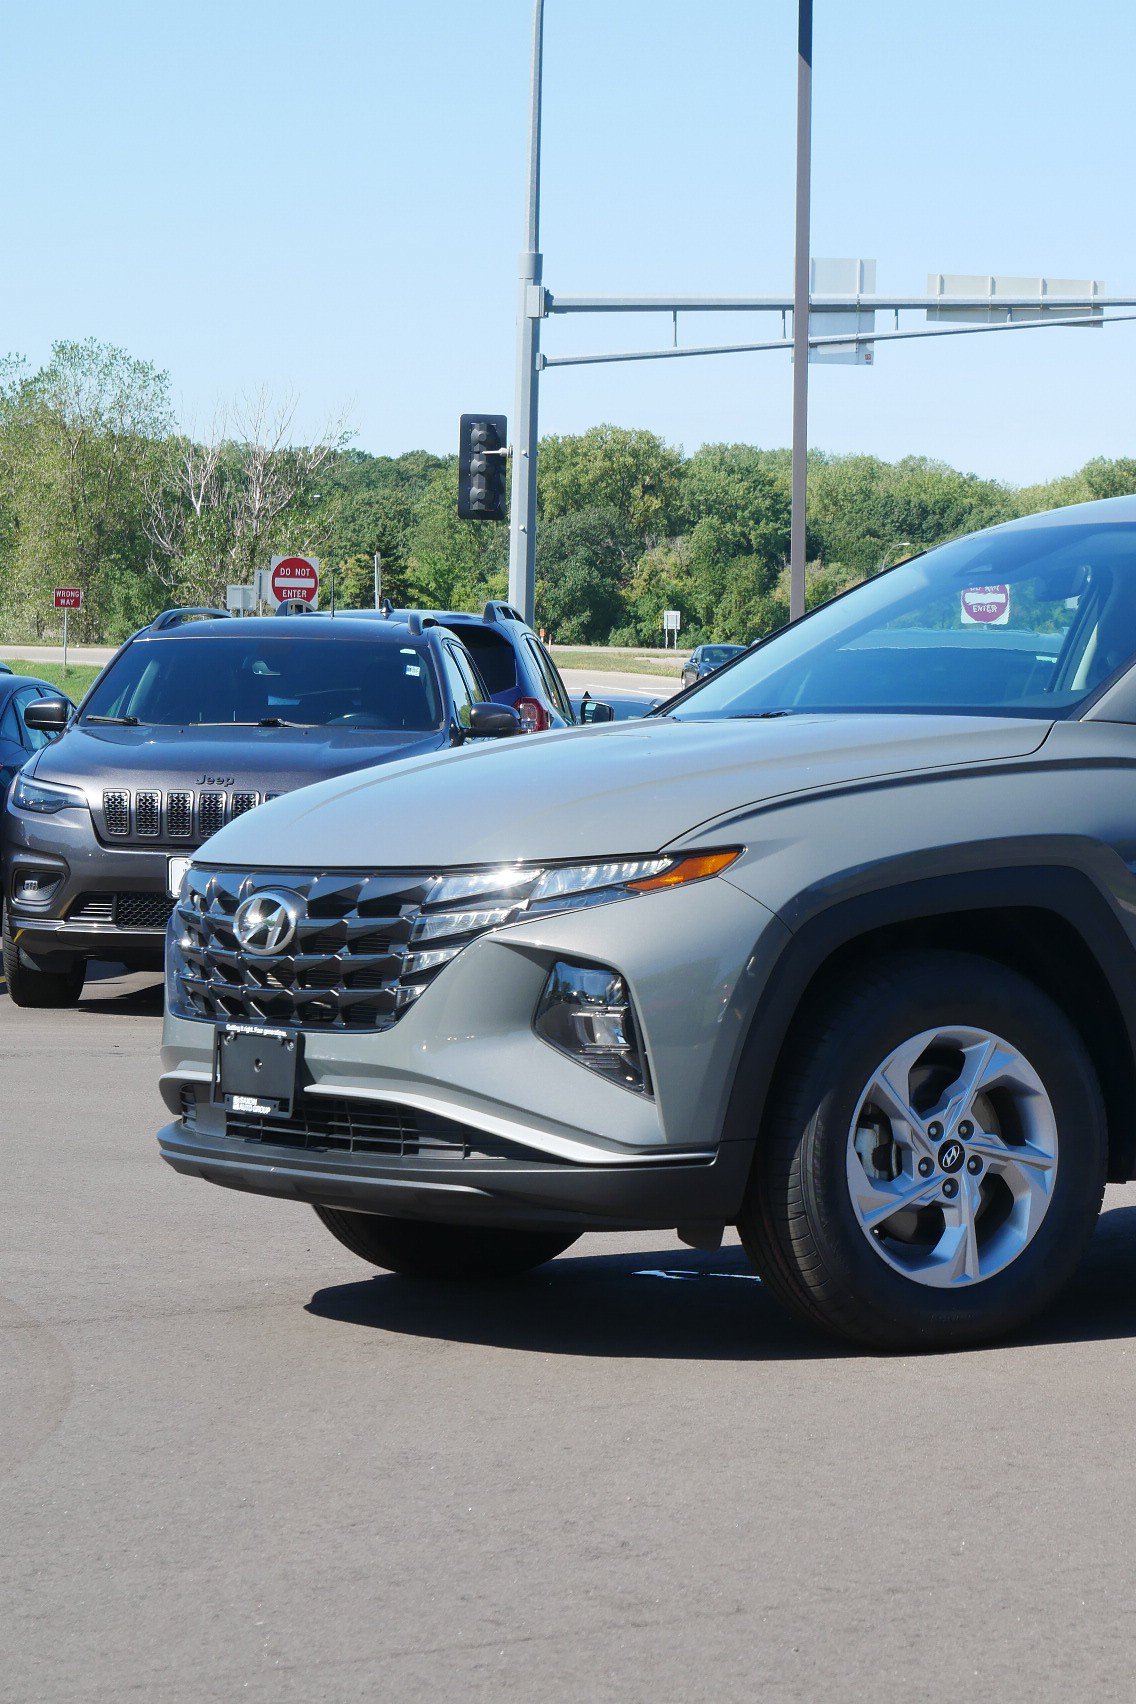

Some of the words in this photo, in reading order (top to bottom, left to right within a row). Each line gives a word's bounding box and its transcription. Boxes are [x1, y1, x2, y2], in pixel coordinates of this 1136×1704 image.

[280, 567, 291, 576] DO
[295, 568, 311, 577] NOT
[56, 590, 80, 598] WRONG
[282, 589, 307, 598] ENTER
[60, 598, 75, 606] WAY
[972, 604, 998, 613] ENTER
[195, 774, 235, 788] Jeep
